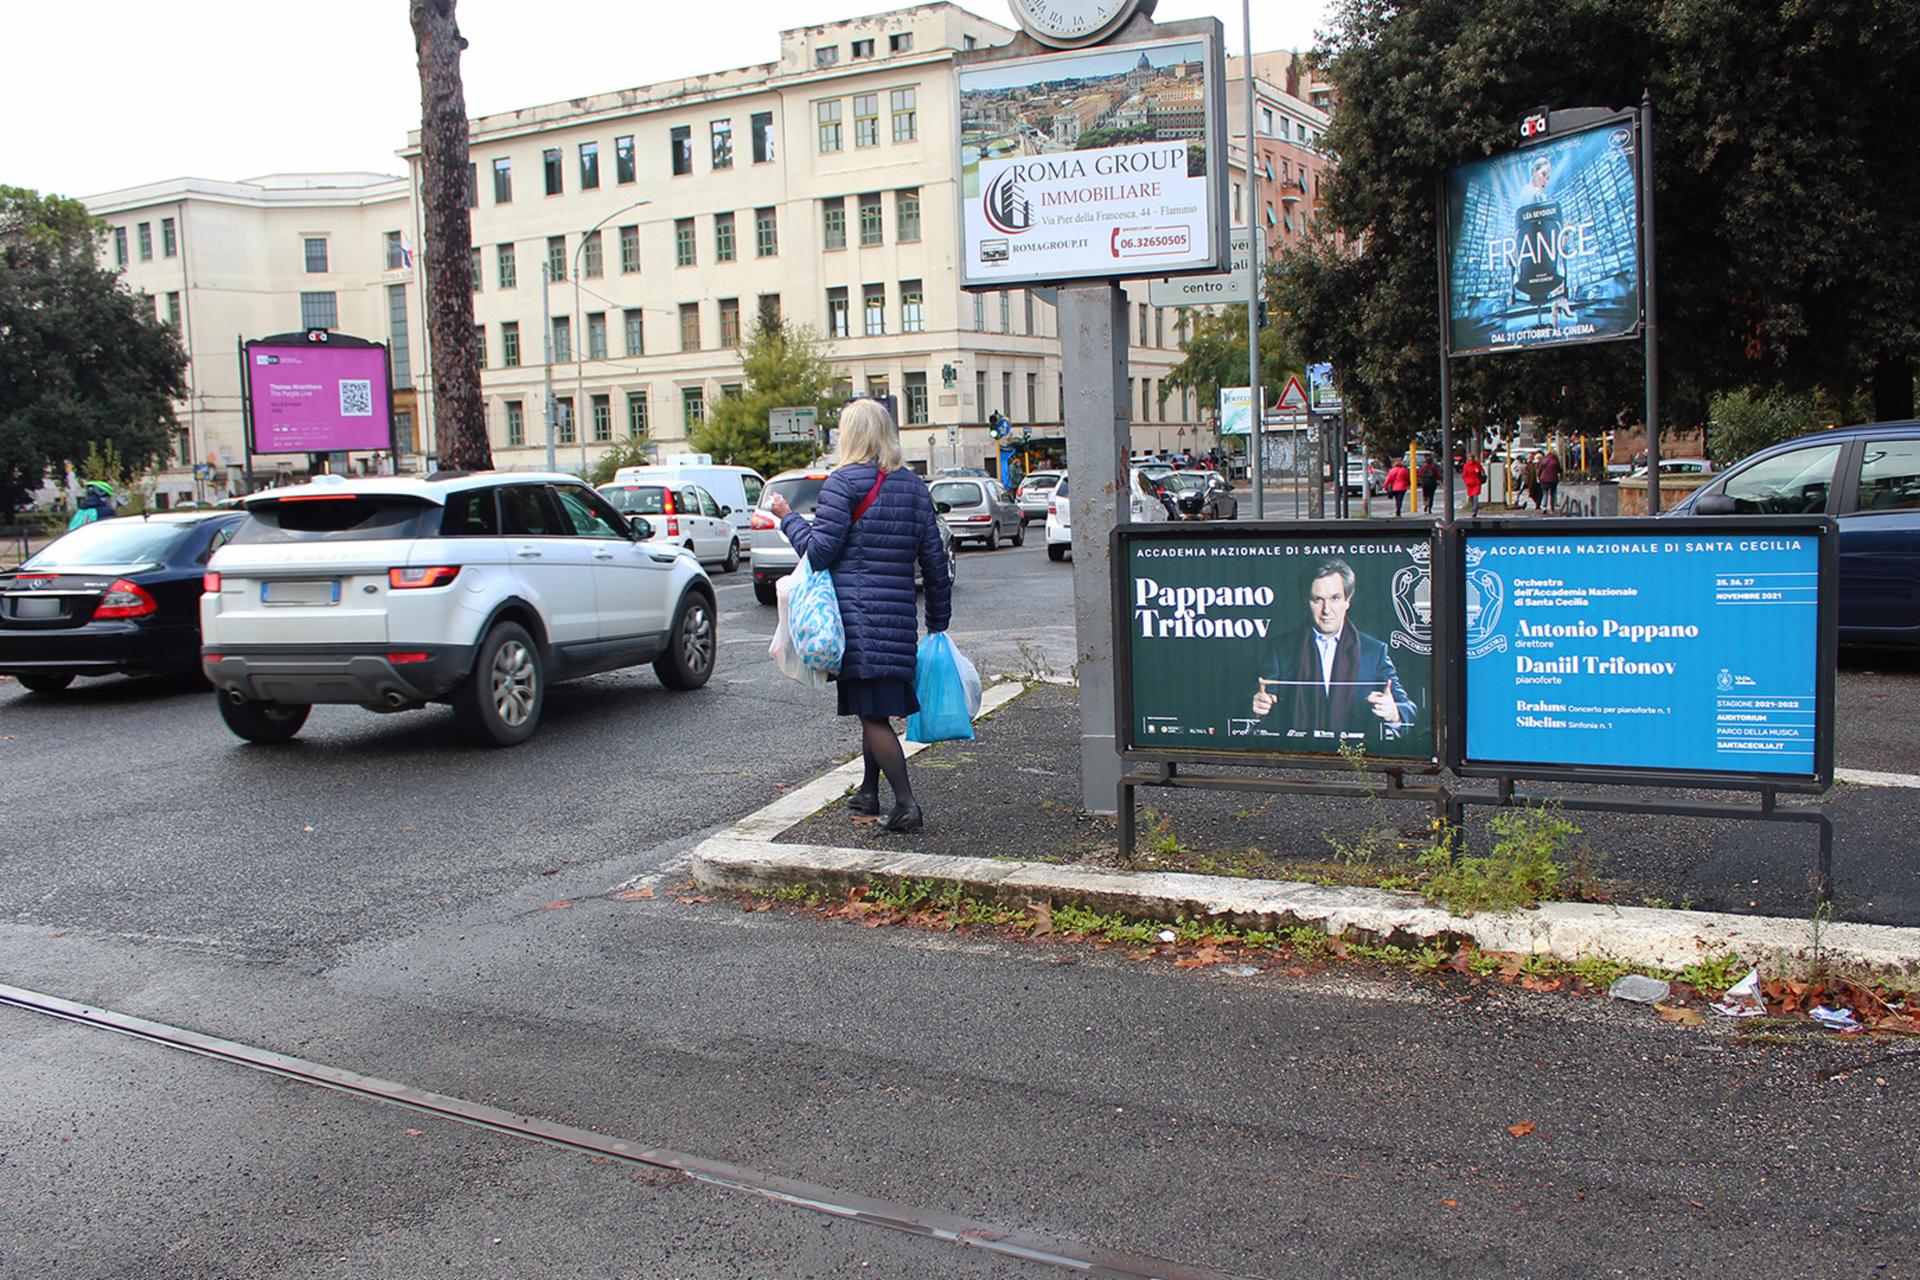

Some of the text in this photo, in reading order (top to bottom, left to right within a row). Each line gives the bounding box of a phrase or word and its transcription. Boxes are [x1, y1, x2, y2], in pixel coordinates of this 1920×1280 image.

[1012, 148, 1184, 184] ROMA GROUP
[1041, 182, 1161, 207] IMMOBILIARE
[1042, 215, 1057, 225] Via
[1058, 214, 1073, 224] Pier
[1075, 212, 1095, 223] della
[1095, 209, 1138, 222] Francesca,
[1139, 207, 1151, 216] 44
[1160, 204, 1198, 216] Flaminio
[1012, 238, 1089, 253] ROMAGROUP.IT
[1120, 234, 1187, 249] 06.32650505
[1488, 221, 1596, 271] FRANCE
[1182, 282, 1223, 294] centro
[1491, 324, 1595, 343] DAL 21 OTTOBRE AL CINEMA
[1136, 544, 1403, 558] ACCADEMIA NAZIONALE DI SANTA CECILIA
[1490, 540, 1802, 556] ACCADEMIA NAZIONALE DI SANTA CECILIA
[1513, 578, 1563, 587] Orchestra
[1135, 578, 1275, 614] Pappano
[1588, 587, 1638, 597] Nazionale
[1716, 592, 1782, 600] NOVEMBRE 2021
[1513, 598, 1589, 607] di Santa Cecilia
[1135, 608, 1272, 639] Trifonov
[1515, 620, 1699, 643] Antonio Pappano
[1515, 640, 1554, 648] direttore
[1516, 655, 1677, 675] Daniil Trifonov
[1515, 675, 1562, 685] pianoforte
[1516, 700, 1567, 712] Brahms
[1567, 705, 1602, 713] Concerto
[1603, 707, 1616, 715] per
[1617, 706, 1656, 715] pianoforte
[1716, 700, 1799, 709] STAGIONE 2021-2022
[1516, 716, 1567, 729] Sibelius
[1568, 721, 1598, 729] Sinfonia
[1717, 714, 1767, 722] AUDITORIUM
[1717, 727, 1743, 735] PARCO
[1743, 728, 1768, 736] DELLA
[1717, 741, 1784, 750] SANTACECILIA.IT
